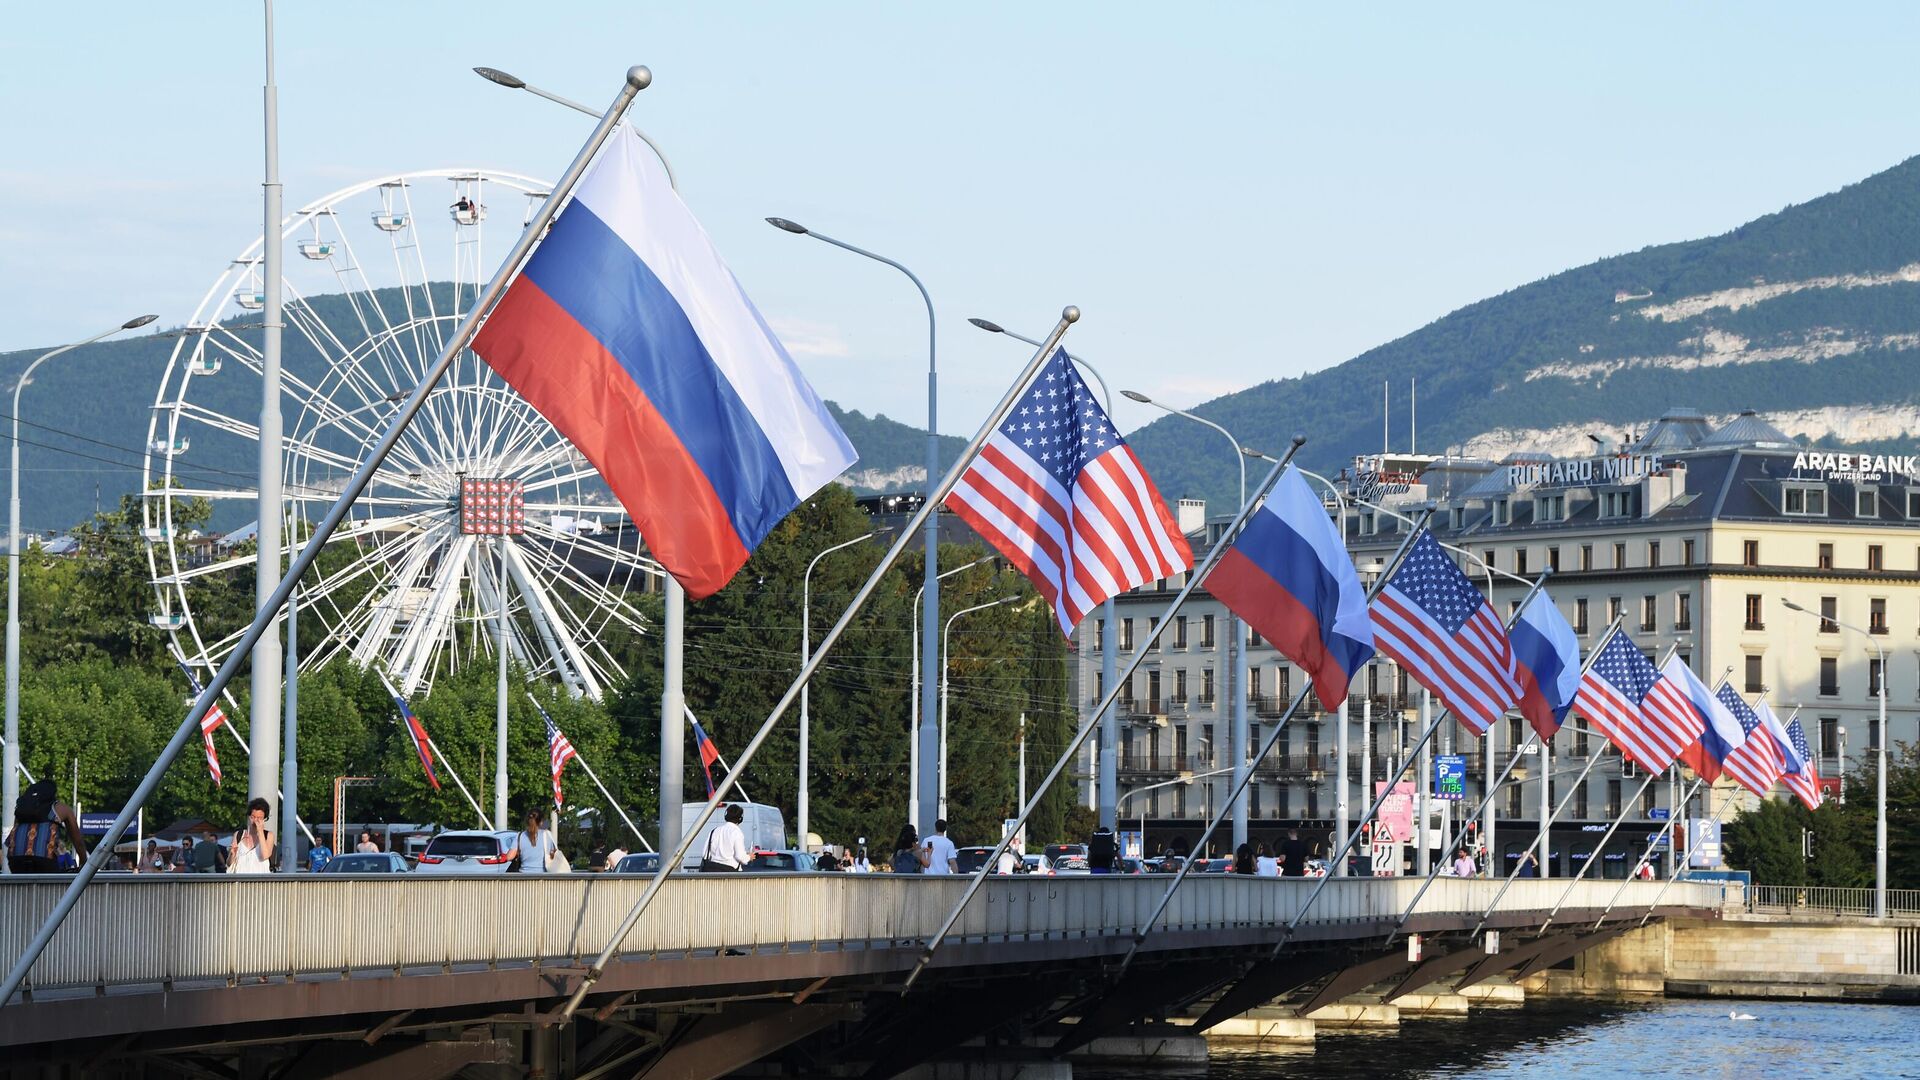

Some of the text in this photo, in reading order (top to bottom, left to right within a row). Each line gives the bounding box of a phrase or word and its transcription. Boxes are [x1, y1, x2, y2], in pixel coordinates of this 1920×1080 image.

[1508, 454, 1663, 486] RICHARD MILLE
[1793, 452, 1917, 473] ARAB BANK
[1358, 471, 1416, 501] Chopard
[1828, 472, 1881, 481] SWITZERLAND
[1442, 784, 1462, 792] 1135
